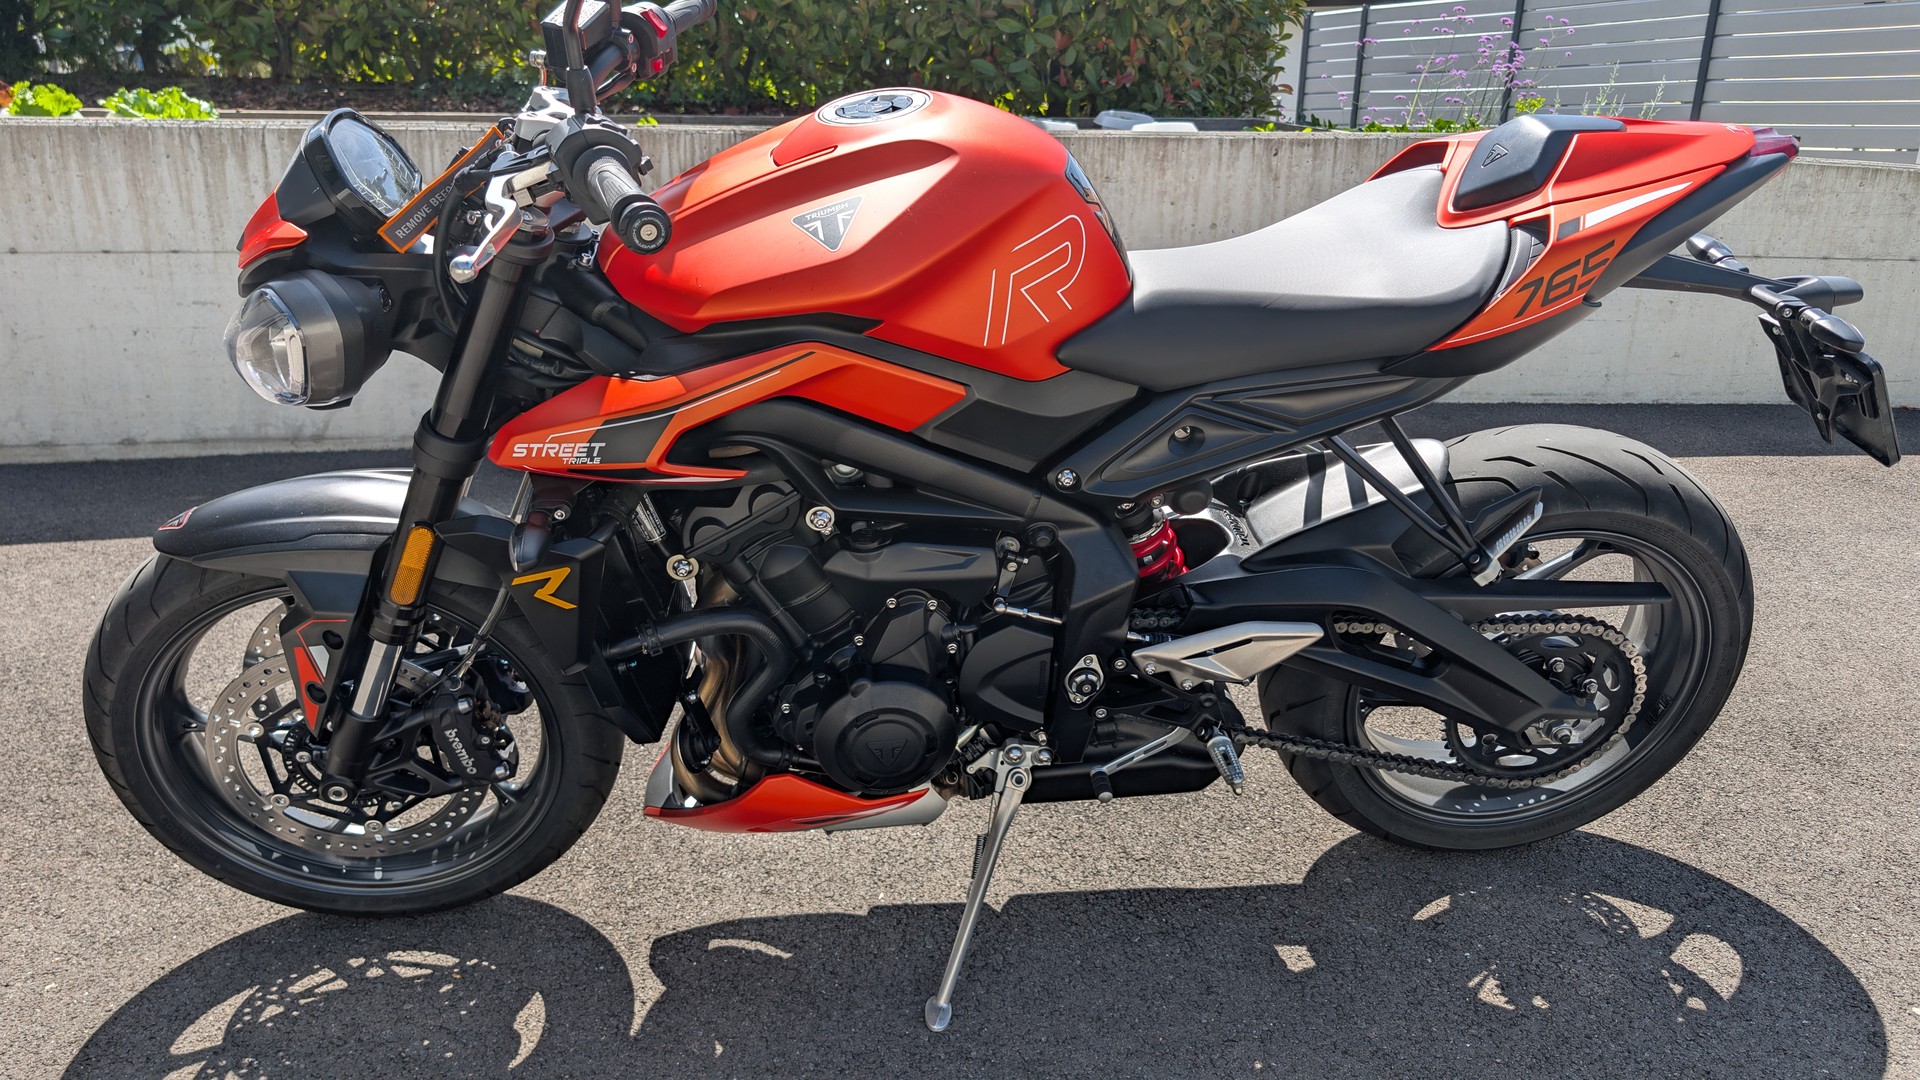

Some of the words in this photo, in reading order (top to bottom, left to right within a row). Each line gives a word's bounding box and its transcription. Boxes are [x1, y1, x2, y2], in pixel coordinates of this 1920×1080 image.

[395, 204, 432, 239] REMOVE
[429, 185, 452, 207] BEFO
[804, 202, 849, 221] TRIUMPH
[983, 213, 1086, 347] R
[1513, 239, 1616, 320] 765
[512, 442, 606, 458] STREET
[562, 457, 601, 465] TRIPLE
[444, 728, 477, 775] brembo
